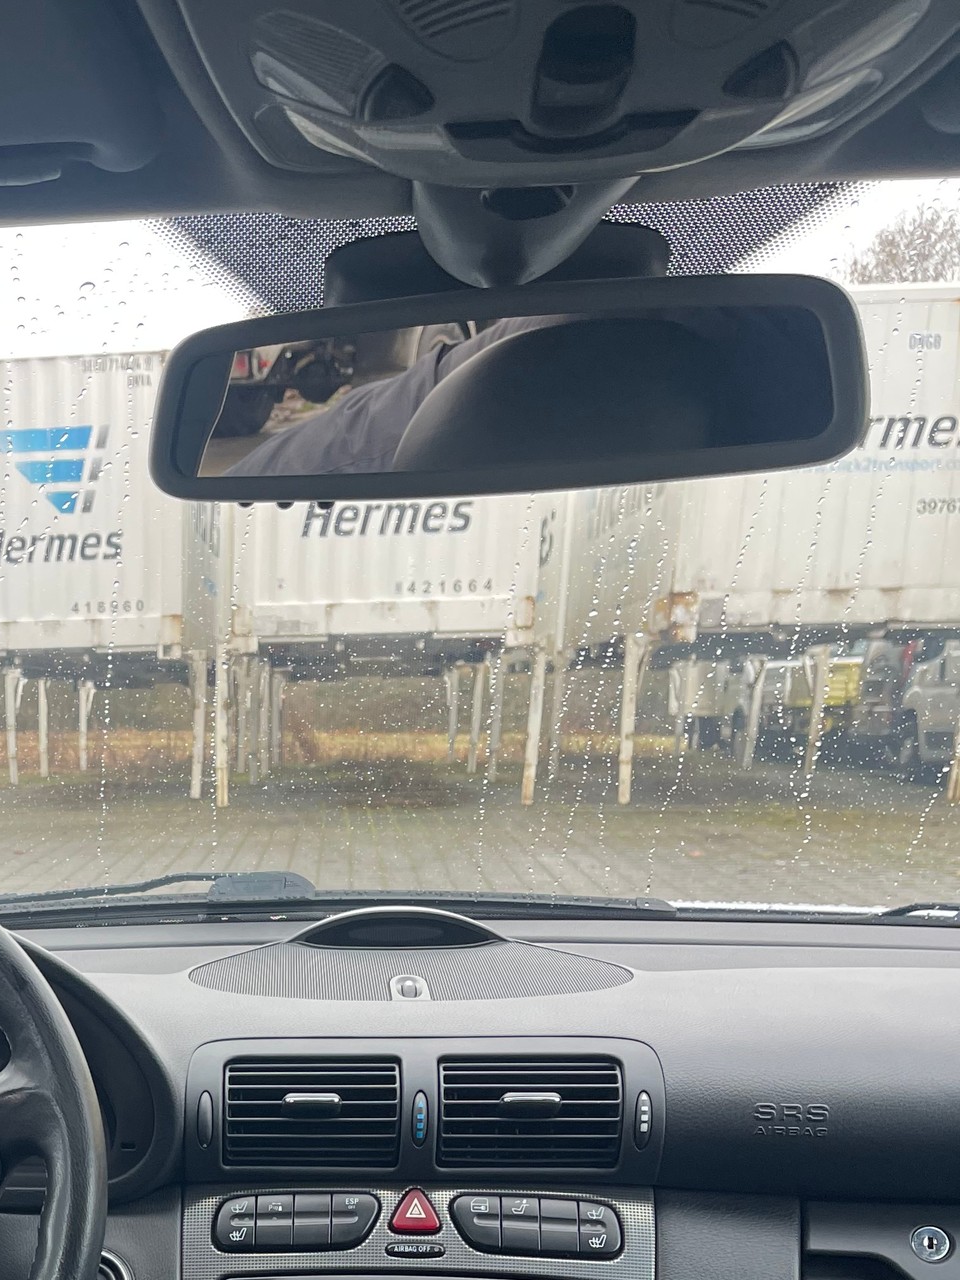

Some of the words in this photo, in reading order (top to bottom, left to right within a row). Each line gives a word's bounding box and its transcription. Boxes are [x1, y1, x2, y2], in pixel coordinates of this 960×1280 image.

[858, 415, 960, 449] rme
[301, 500, 474, 537] Hermes
[753, 1102, 830, 1121] SRS
[753, 1125, 828, 1137] AIRBAG
[345, 1197, 359, 1205] ESP
